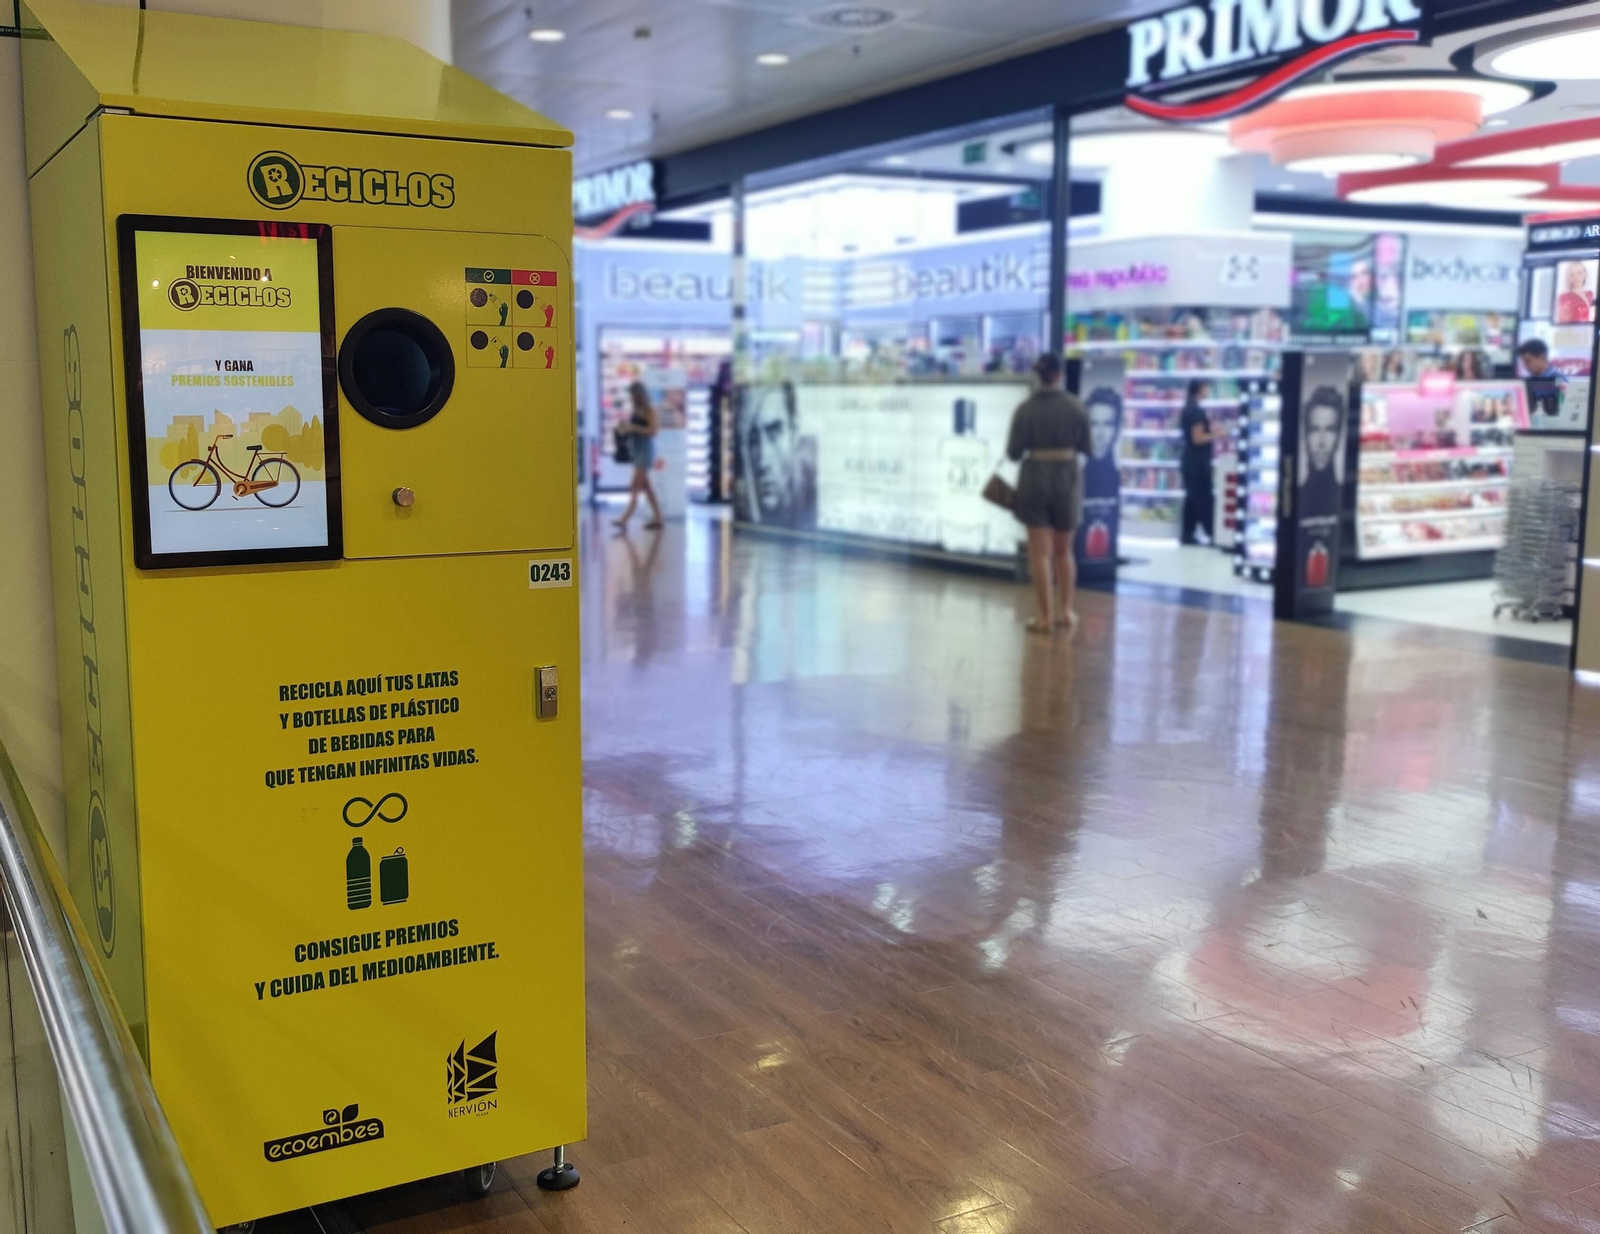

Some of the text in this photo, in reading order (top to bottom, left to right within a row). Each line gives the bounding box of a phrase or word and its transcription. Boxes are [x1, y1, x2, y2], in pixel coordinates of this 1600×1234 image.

[247, 150, 455, 210] RECICLOS
[186, 265, 273, 281] BIENVENIDO A
[168, 277, 292, 311] RECICLOS
[171, 374, 294, 387] PREMIOS SOSTENIBLES
[215, 360, 254, 372] Y GANA
[530, 563, 570, 582] 0243
[279, 670, 459, 701] RECICLA AQUÍ TUS LATAS
[279, 697, 459, 729] Y BOTELLAS DE PLÁSTICO
[308, 726, 435, 754] DE BEBIDAS PARA
[265, 748, 479, 788] QUE TENGAN INFINITAS VIDAS.
[294, 918, 459, 963] CONSIGUE PREMIOS
[254, 941, 500, 1001] Y CUIDA DEL MEDIOAMBIENTE.
[448, 1099, 498, 1118] NERVIÓN
[269, 1120, 380, 1158] ecoembes
